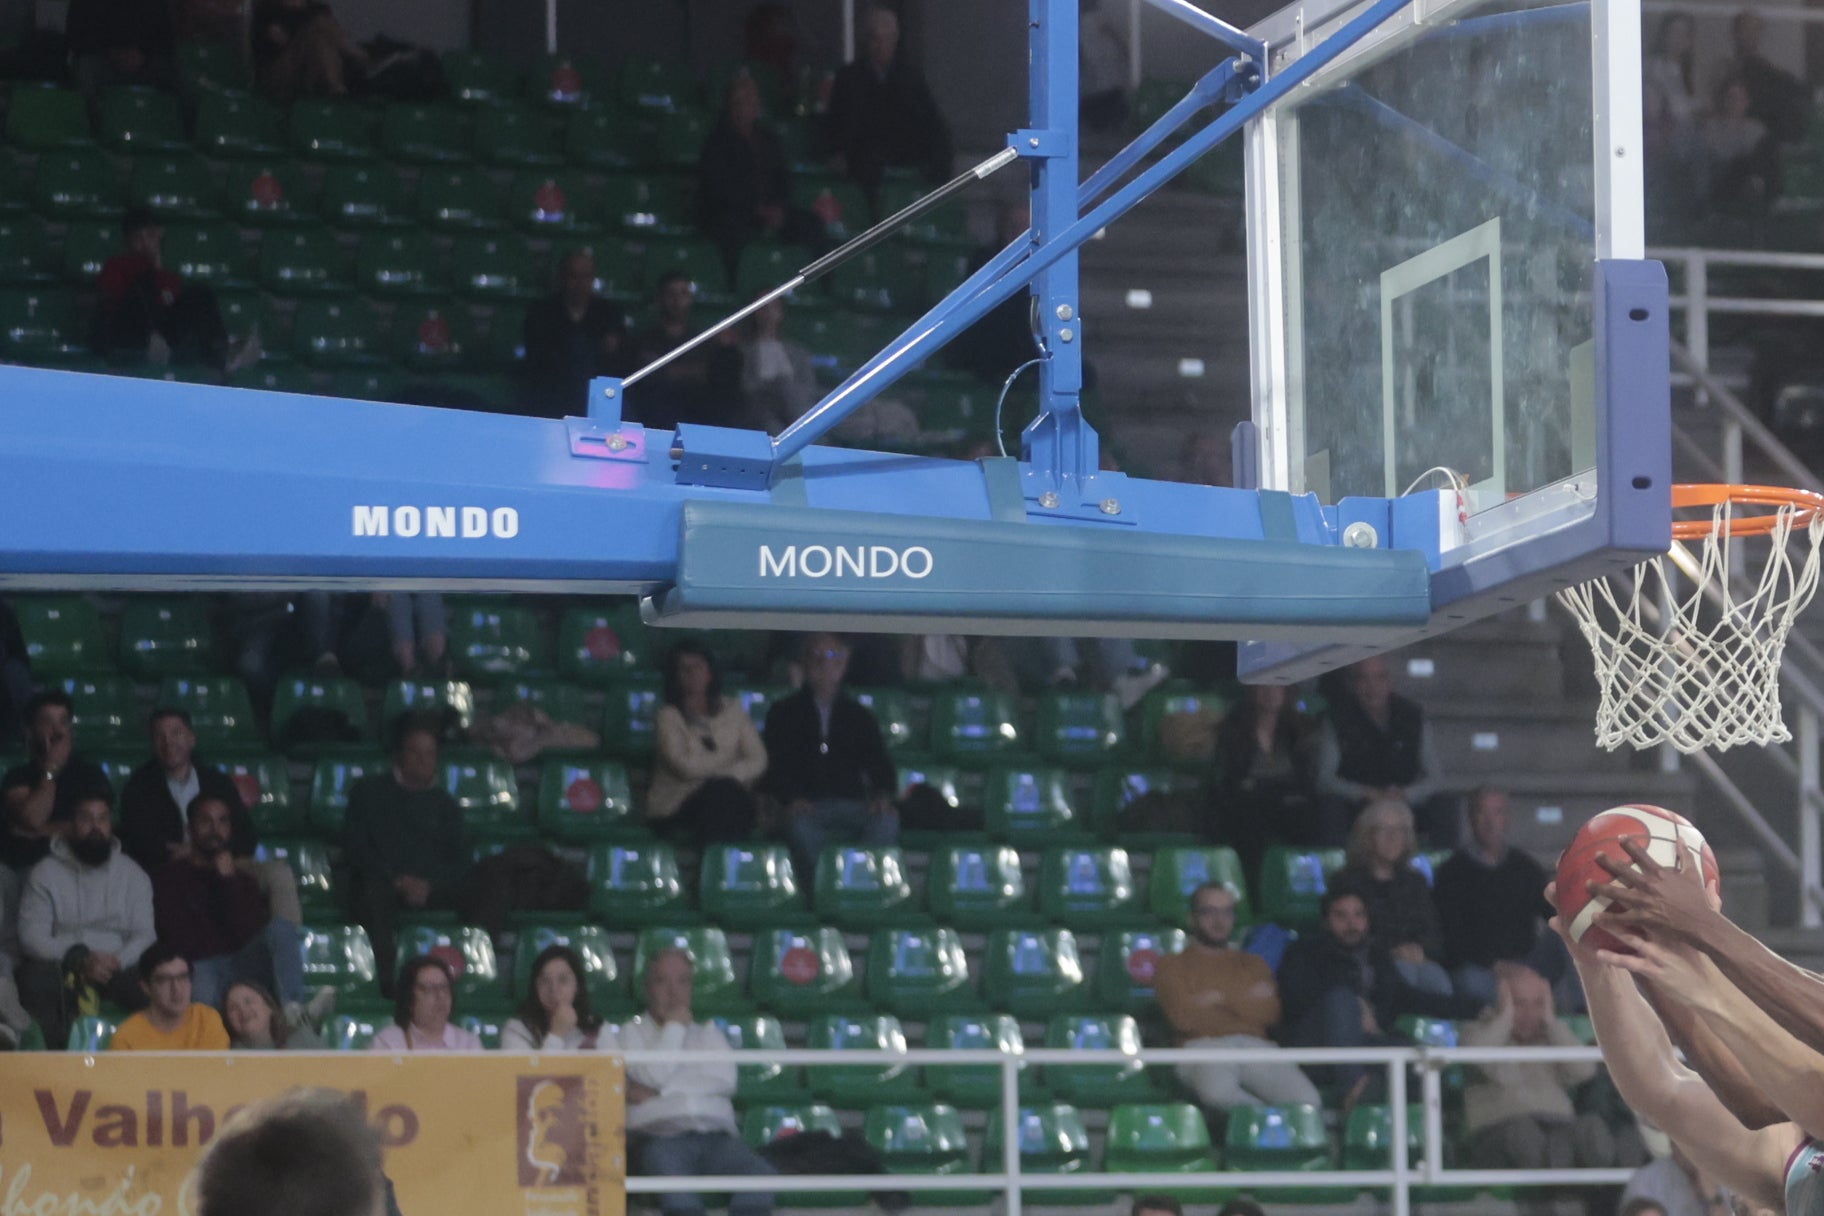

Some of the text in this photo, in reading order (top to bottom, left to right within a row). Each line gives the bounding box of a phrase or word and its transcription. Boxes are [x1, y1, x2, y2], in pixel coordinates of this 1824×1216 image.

[352, 504, 519, 539] MONDO
[759, 544, 934, 579] MONDO
[34, 1089, 419, 1148] Valho
